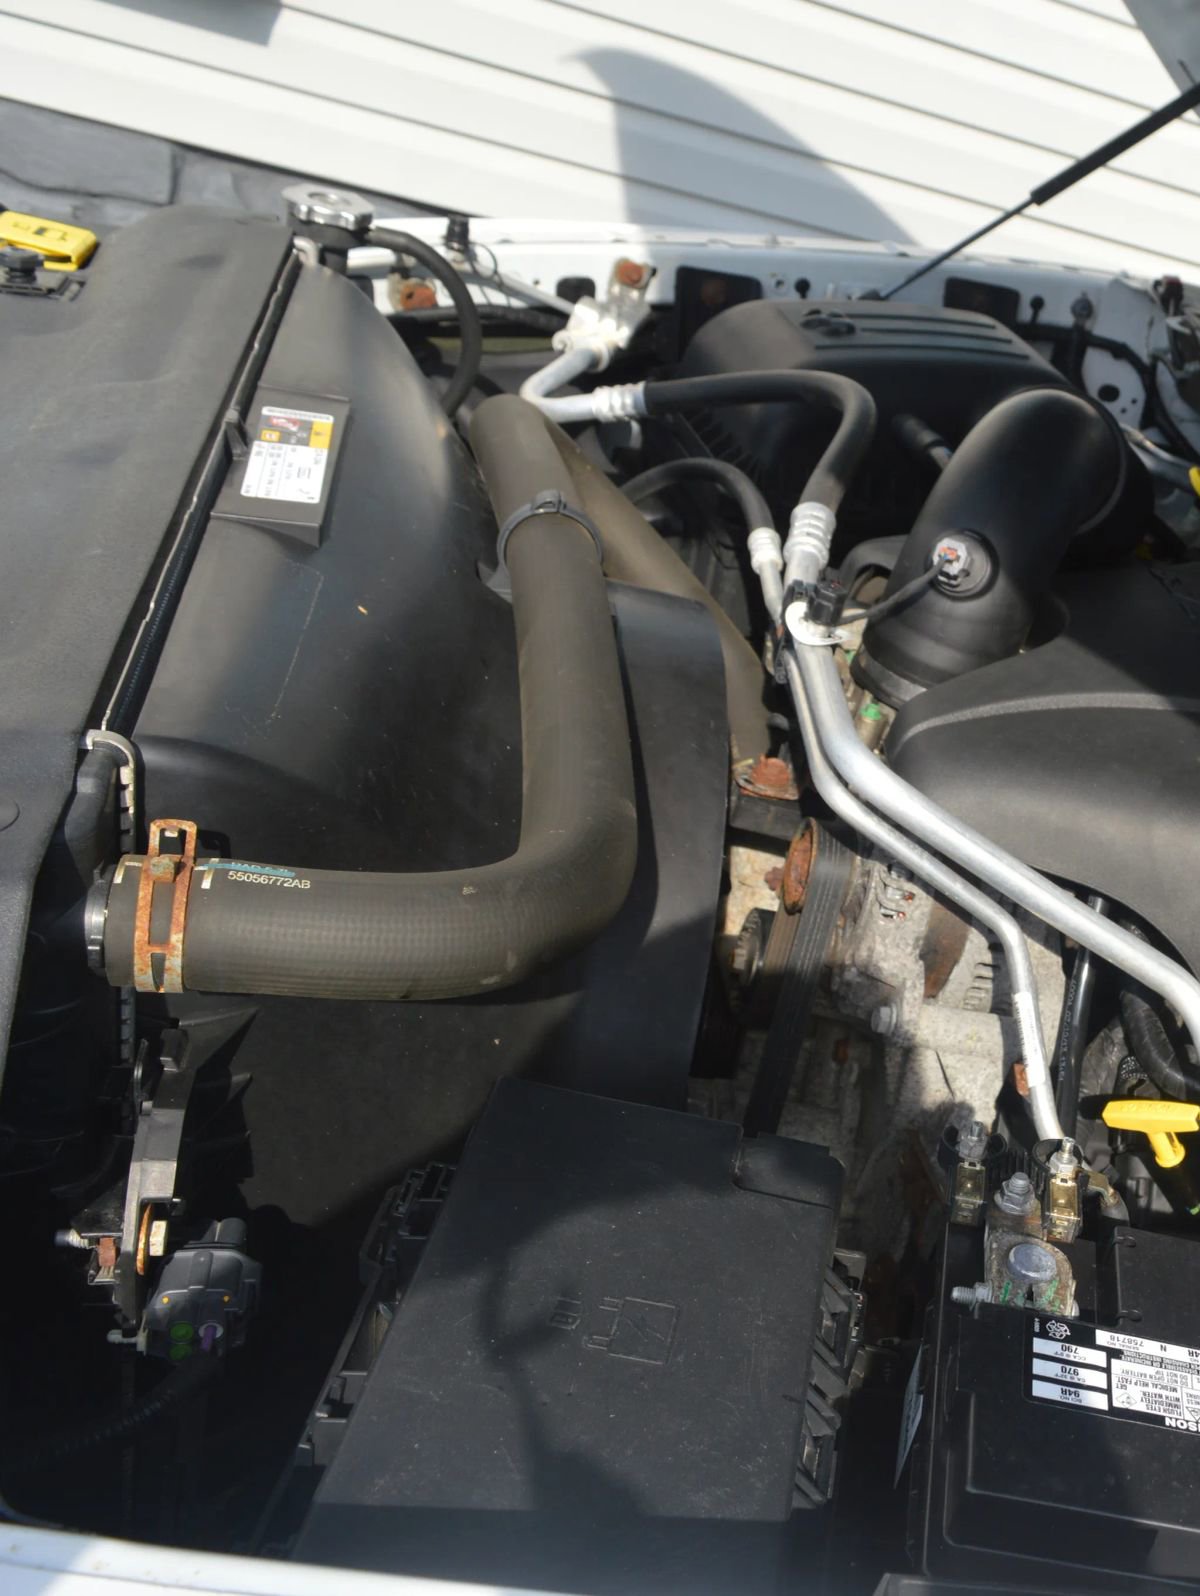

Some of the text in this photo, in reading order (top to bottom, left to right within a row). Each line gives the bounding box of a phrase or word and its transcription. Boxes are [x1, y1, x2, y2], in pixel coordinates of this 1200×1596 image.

[228, 871, 311, 889] 55056772AB
[1060, 1344, 1079, 1354] 790
[1060, 1365, 1079, 1375] 970
[1115, 1375, 1177, 1392] MEDICAL HELP FAST.
[1060, 1387, 1080, 1397] 94R
[1140, 1396, 1180, 1409] IMMEDIATELY
[1145, 1404, 1181, 1416] FLUSH EYES
